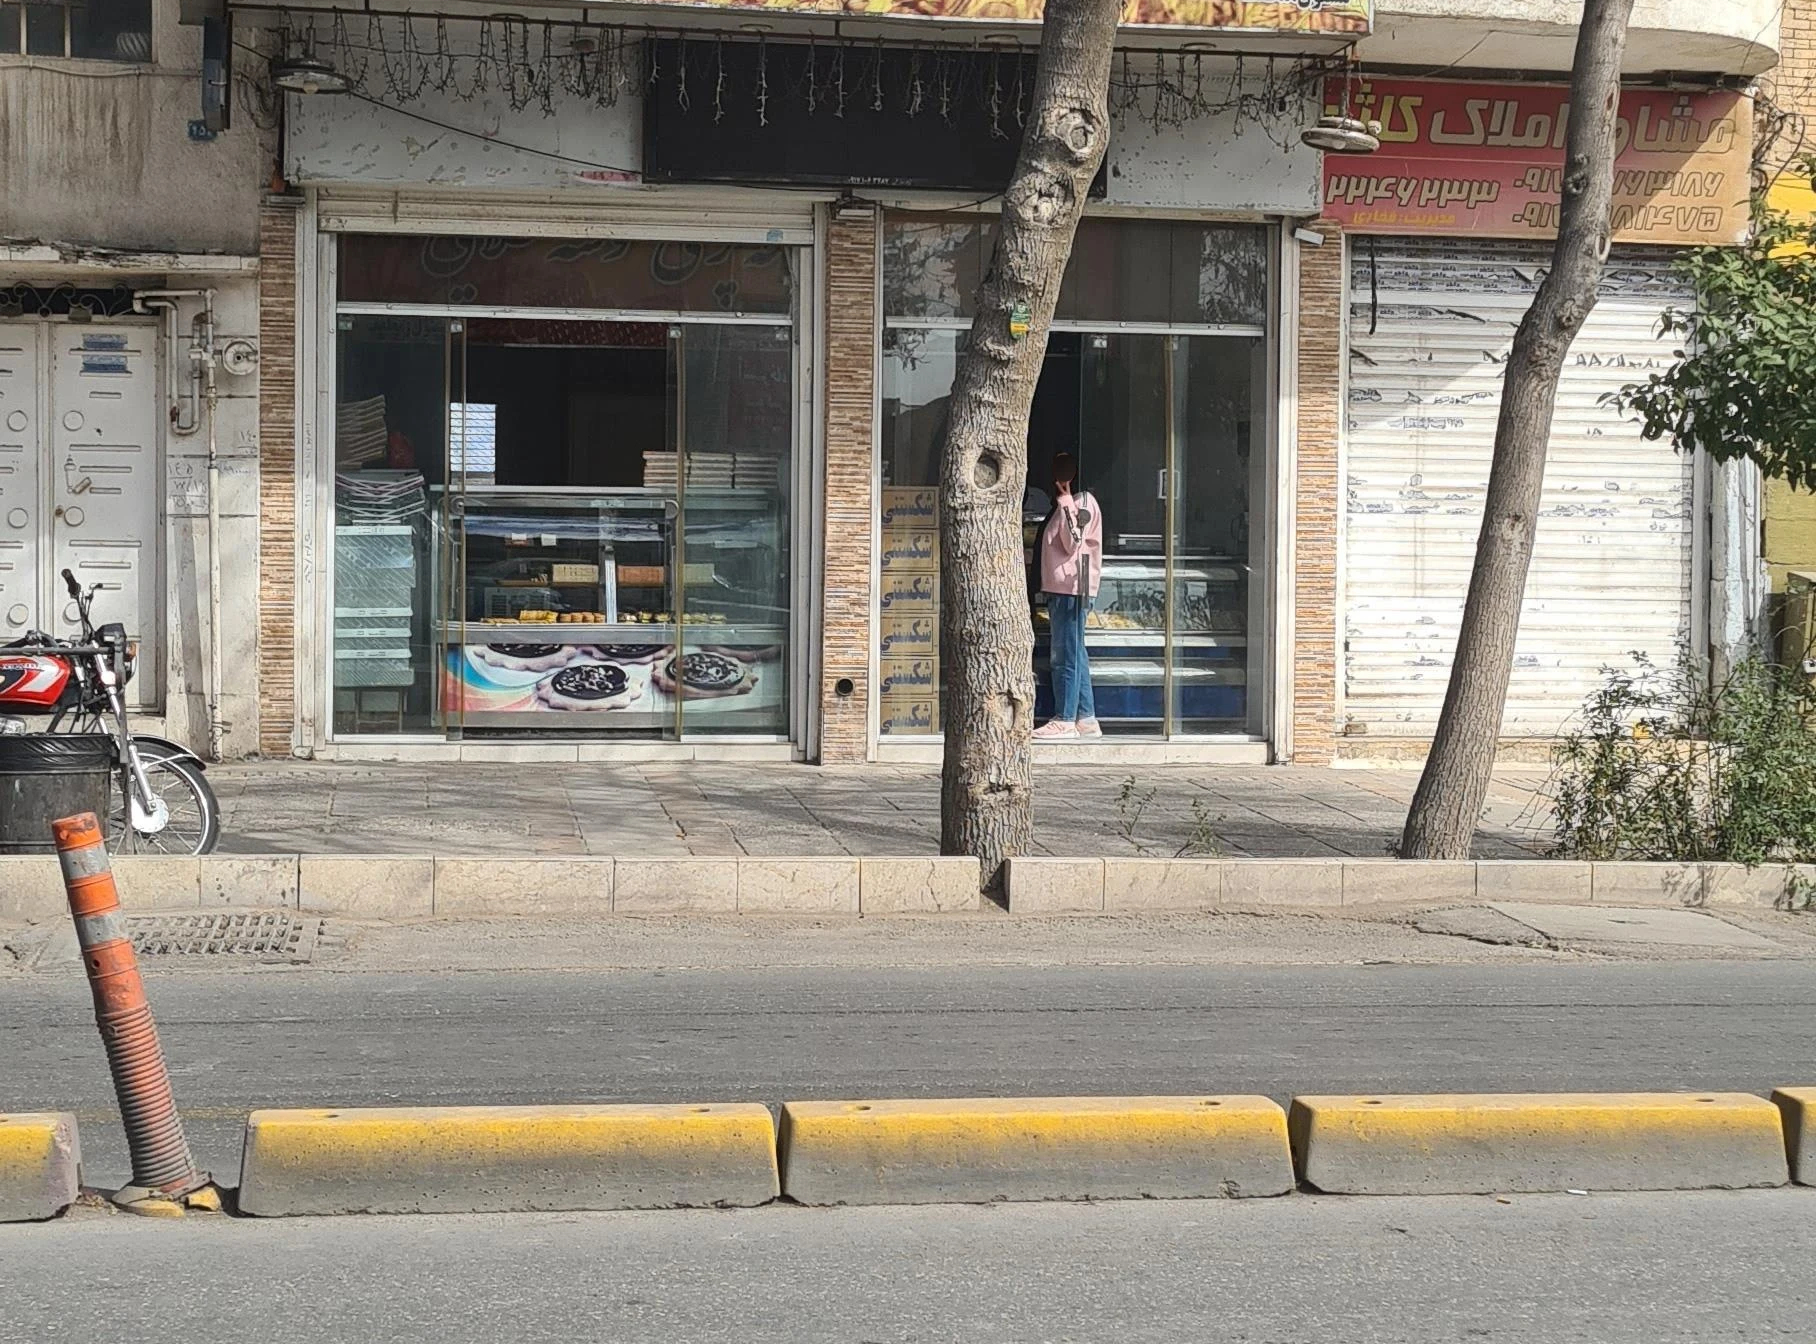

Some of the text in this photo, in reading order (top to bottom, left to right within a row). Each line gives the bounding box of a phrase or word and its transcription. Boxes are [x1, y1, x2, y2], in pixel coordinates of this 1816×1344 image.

[1429, 98, 1569, 149] املاک
[1612, 95, 1738, 159] مشاو
[1512, 202, 1724, 233] ۰۹۱۸۱۴۷۵
